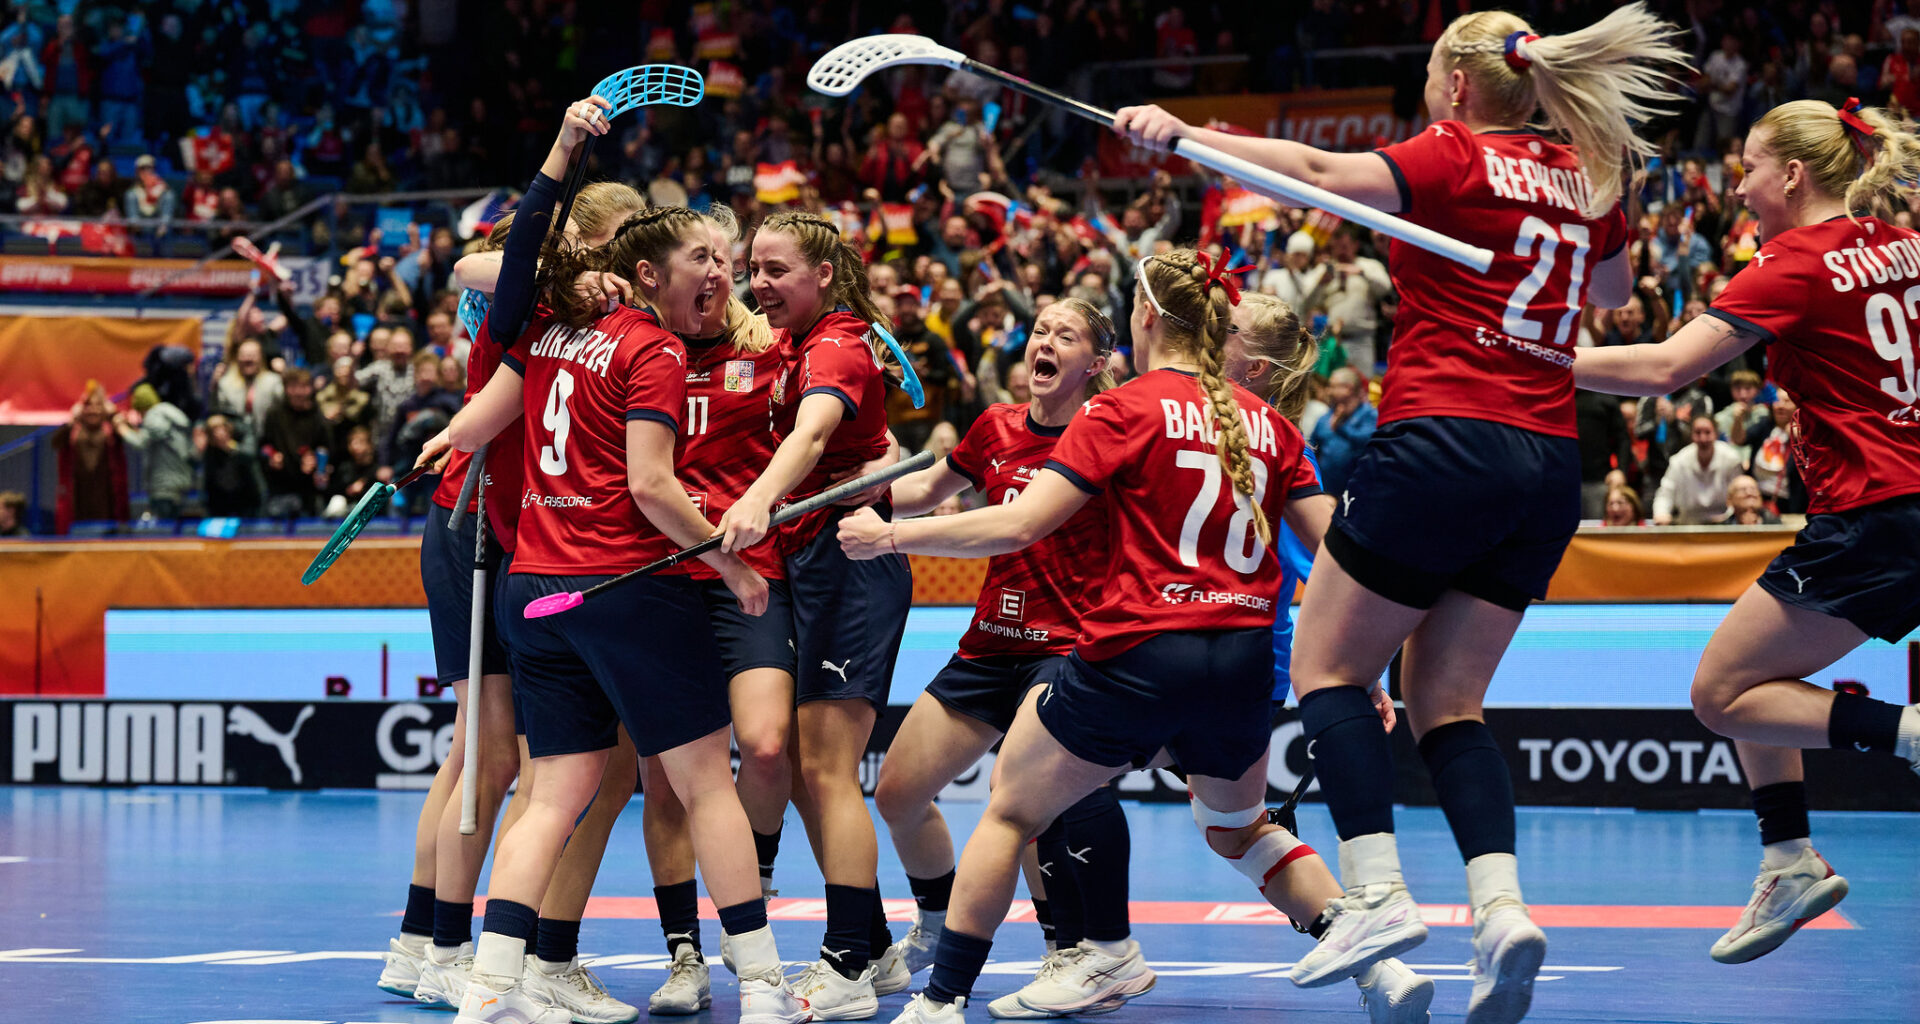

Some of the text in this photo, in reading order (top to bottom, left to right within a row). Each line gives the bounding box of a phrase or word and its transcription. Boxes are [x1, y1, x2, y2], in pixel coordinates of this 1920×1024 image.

[1502, 216, 1590, 345] 27
[540, 368, 574, 476] 9
[687, 396, 709, 435] 11
[1176, 450, 1268, 574] 78
[979, 620, 1049, 641] SKUPINA ČEZ
[1190, 590, 1271, 611] FLASHSCORE
[13, 704, 224, 783] PUMA
[1518, 738, 1741, 783] TOYOTA
